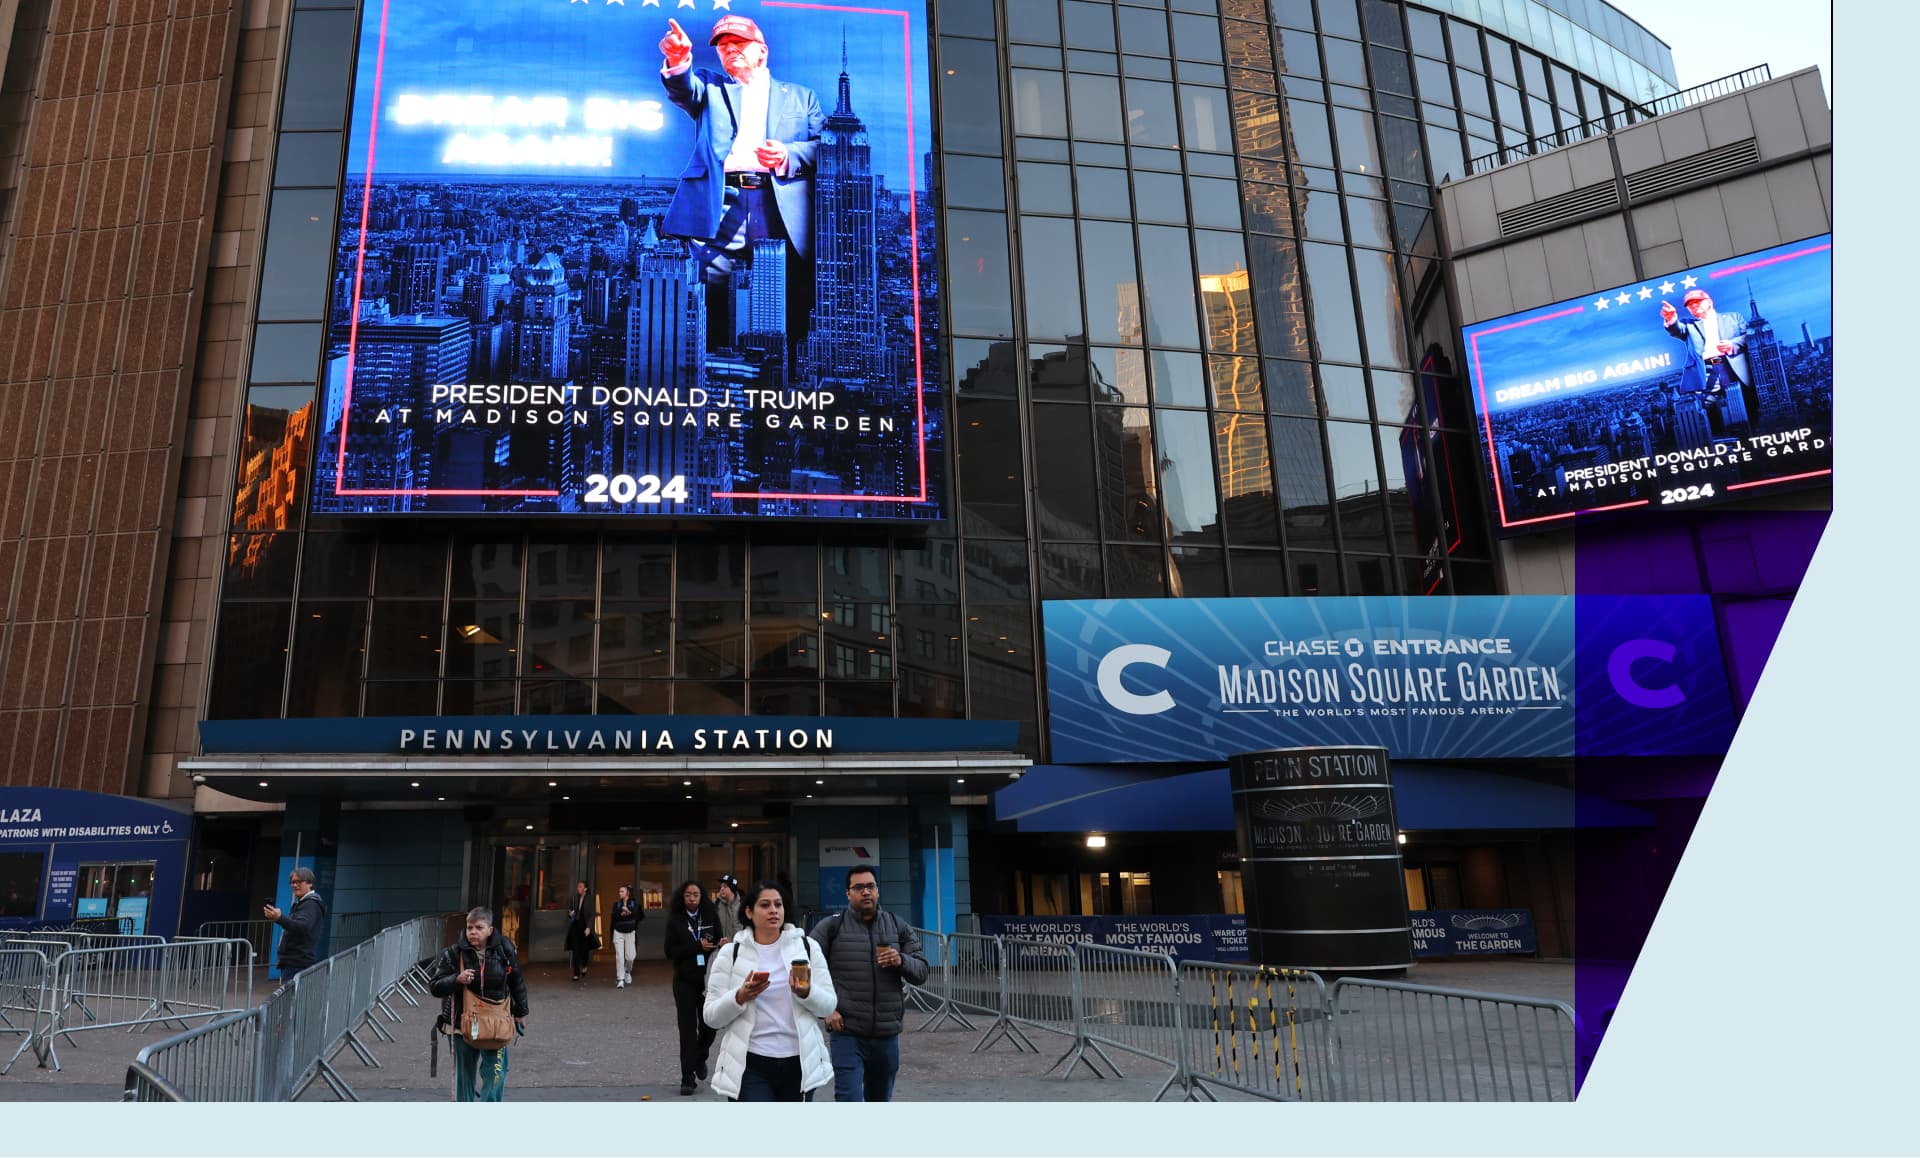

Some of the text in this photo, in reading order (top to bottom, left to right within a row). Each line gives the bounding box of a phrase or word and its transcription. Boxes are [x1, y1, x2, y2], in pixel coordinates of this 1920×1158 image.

[398, 94, 663, 130] DREAM BIG
[442, 133, 613, 167] AGAIN!
[1495, 352, 1672, 403] DREAM BIG AGAIN!
[431, 384, 836, 411] PRESIDENT DONALD J. TRUMP
[375, 409, 896, 433] AT MADISON SQUARE GARDEN
[1563, 427, 1812, 483] PRESIDENT DONALD J. TRUMP
[1536, 436, 1831, 498] AT MADISON SQUARE GARD
[583, 473, 689, 505] 2024
[1660, 482, 1716, 505] 2024
[1264, 637, 1513, 656] CHASE ENTRANCE
[1096, 643, 1178, 716] C
[1217, 664, 1341, 704] MADISON
[1349, 662, 1451, 706] SQUARE
[1606, 638, 1686, 710] C
[1274, 706, 1514, 717] THE WORLD'S MOST FAMOUS ARENA
[399, 728, 835, 751] PENNSYLVANIA STATION
[1308, 753, 1379, 779] STATION
[41, 827, 66, 838] WITH
[68, 825, 131, 837] DISABILITIES
[133, 824, 161, 836] ONLY
[1003, 923, 1082, 933] THE WORLD'S
[1035, 933, 1095, 945] FAMOUS
[1105, 932, 1203, 945] MOST FAMOUS
[1115, 922, 1190, 933] THE WORLD'S
[1236, 929, 1247, 937] OF
[1467, 932, 1509, 940] WELCOME TO
[1221, 937, 1248, 945] TICKET
[1455, 938, 1522, 951] THE GARDEN
